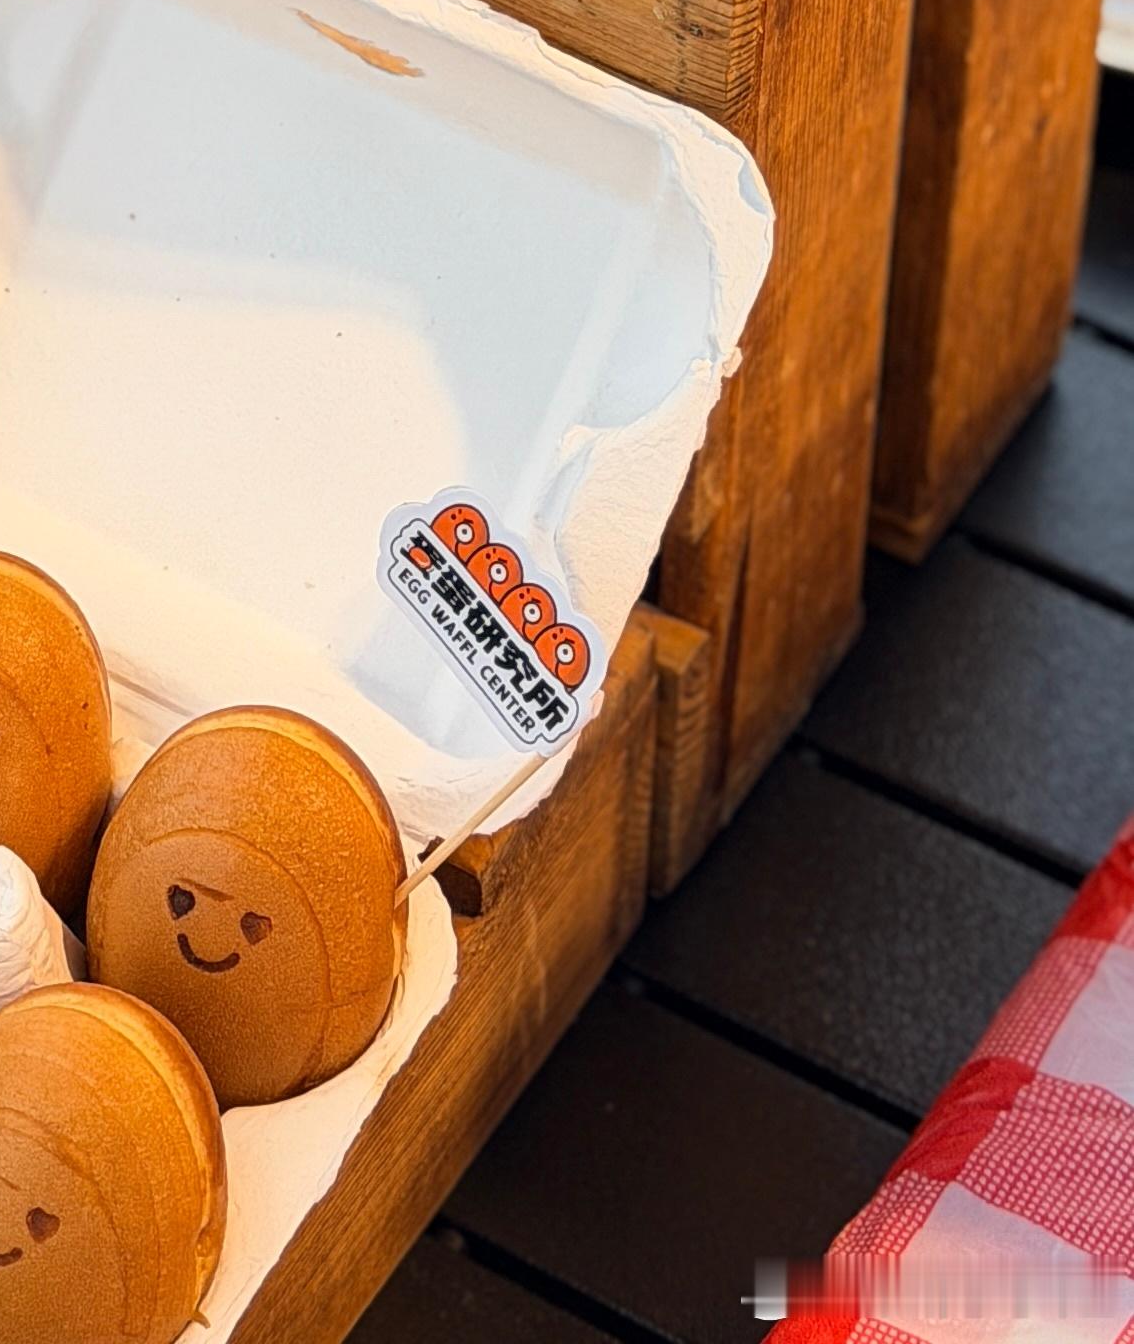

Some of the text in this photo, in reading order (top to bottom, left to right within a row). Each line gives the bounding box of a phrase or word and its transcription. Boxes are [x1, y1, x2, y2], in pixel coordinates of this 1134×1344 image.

[398, 568, 536, 733] EGG WAFFL CENTER
